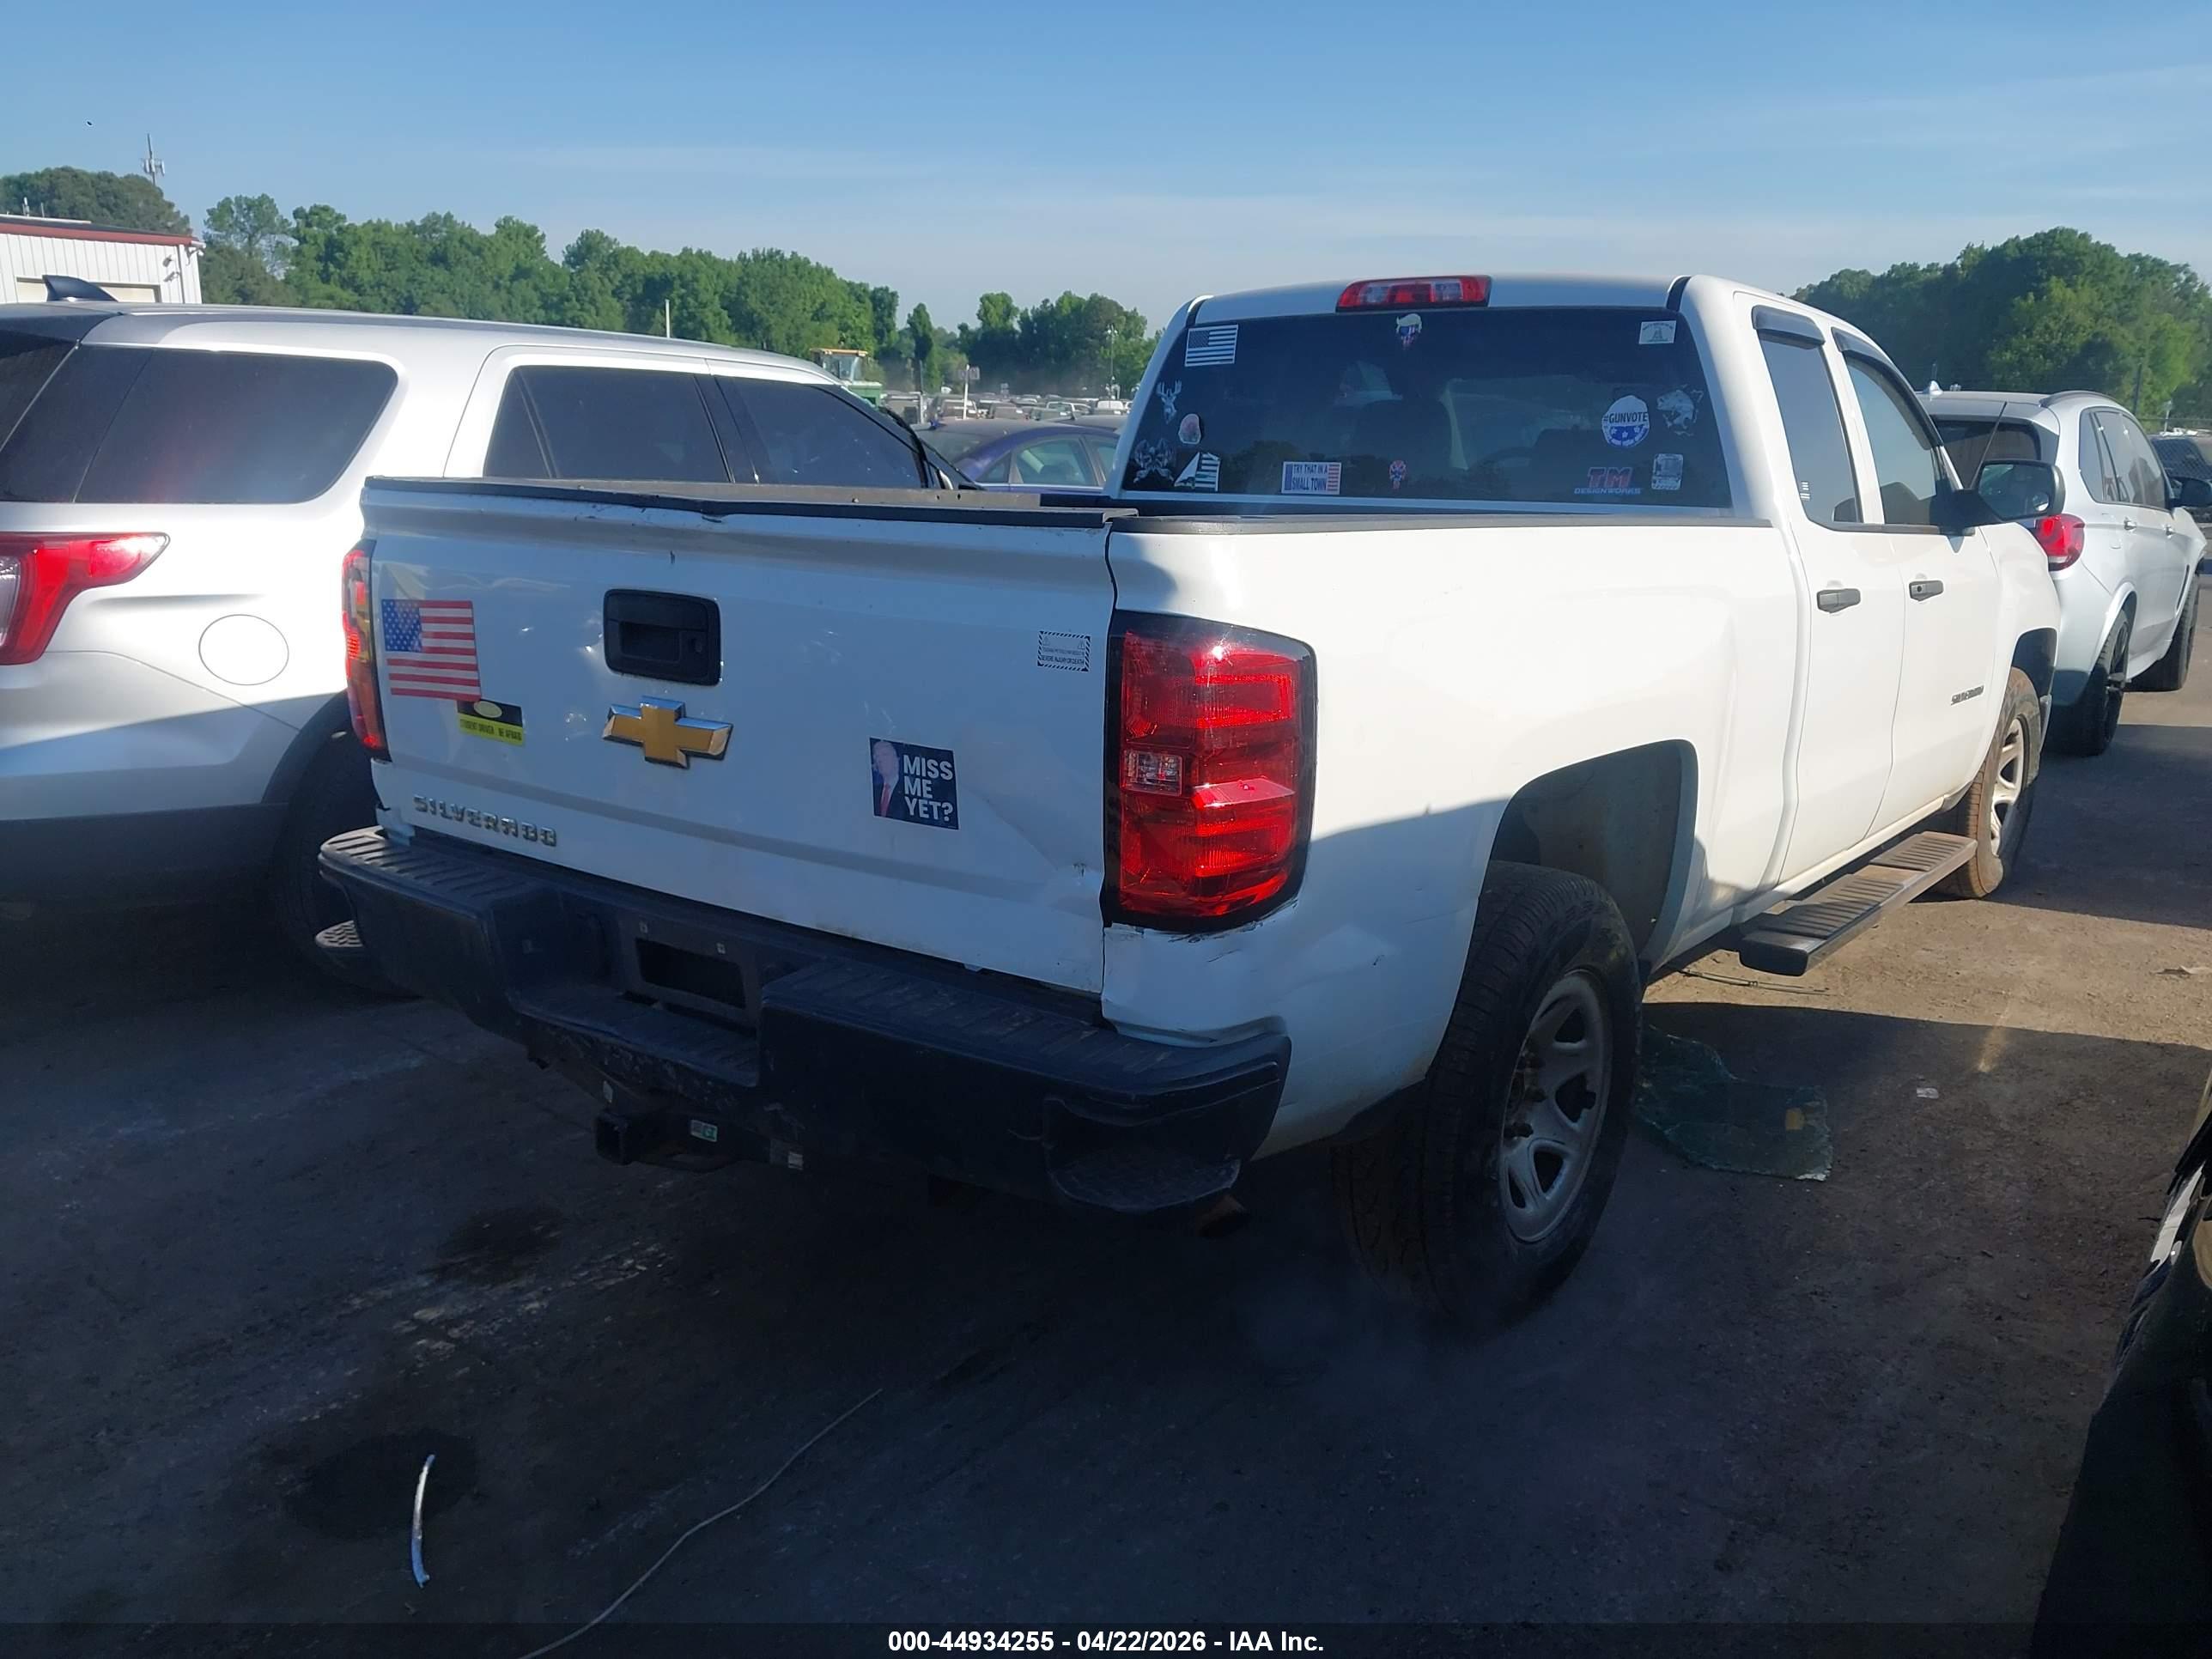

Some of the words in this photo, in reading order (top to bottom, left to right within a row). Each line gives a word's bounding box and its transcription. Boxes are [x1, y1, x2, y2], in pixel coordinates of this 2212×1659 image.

[1603, 412, 1648, 423] #GUNVOTE
[1293, 465, 1303, 474] TRY
[1304, 465, 1317, 474] THAT
[1587, 466, 1633, 488] TM
[1292, 477, 1310, 490] SMALL
[1310, 477, 1327, 491] TOWN
[902, 755, 953, 781] MISS
[903, 775, 933, 799] ME
[412, 794, 557, 847] SILVERADO
[904, 796, 953, 822] YET?
